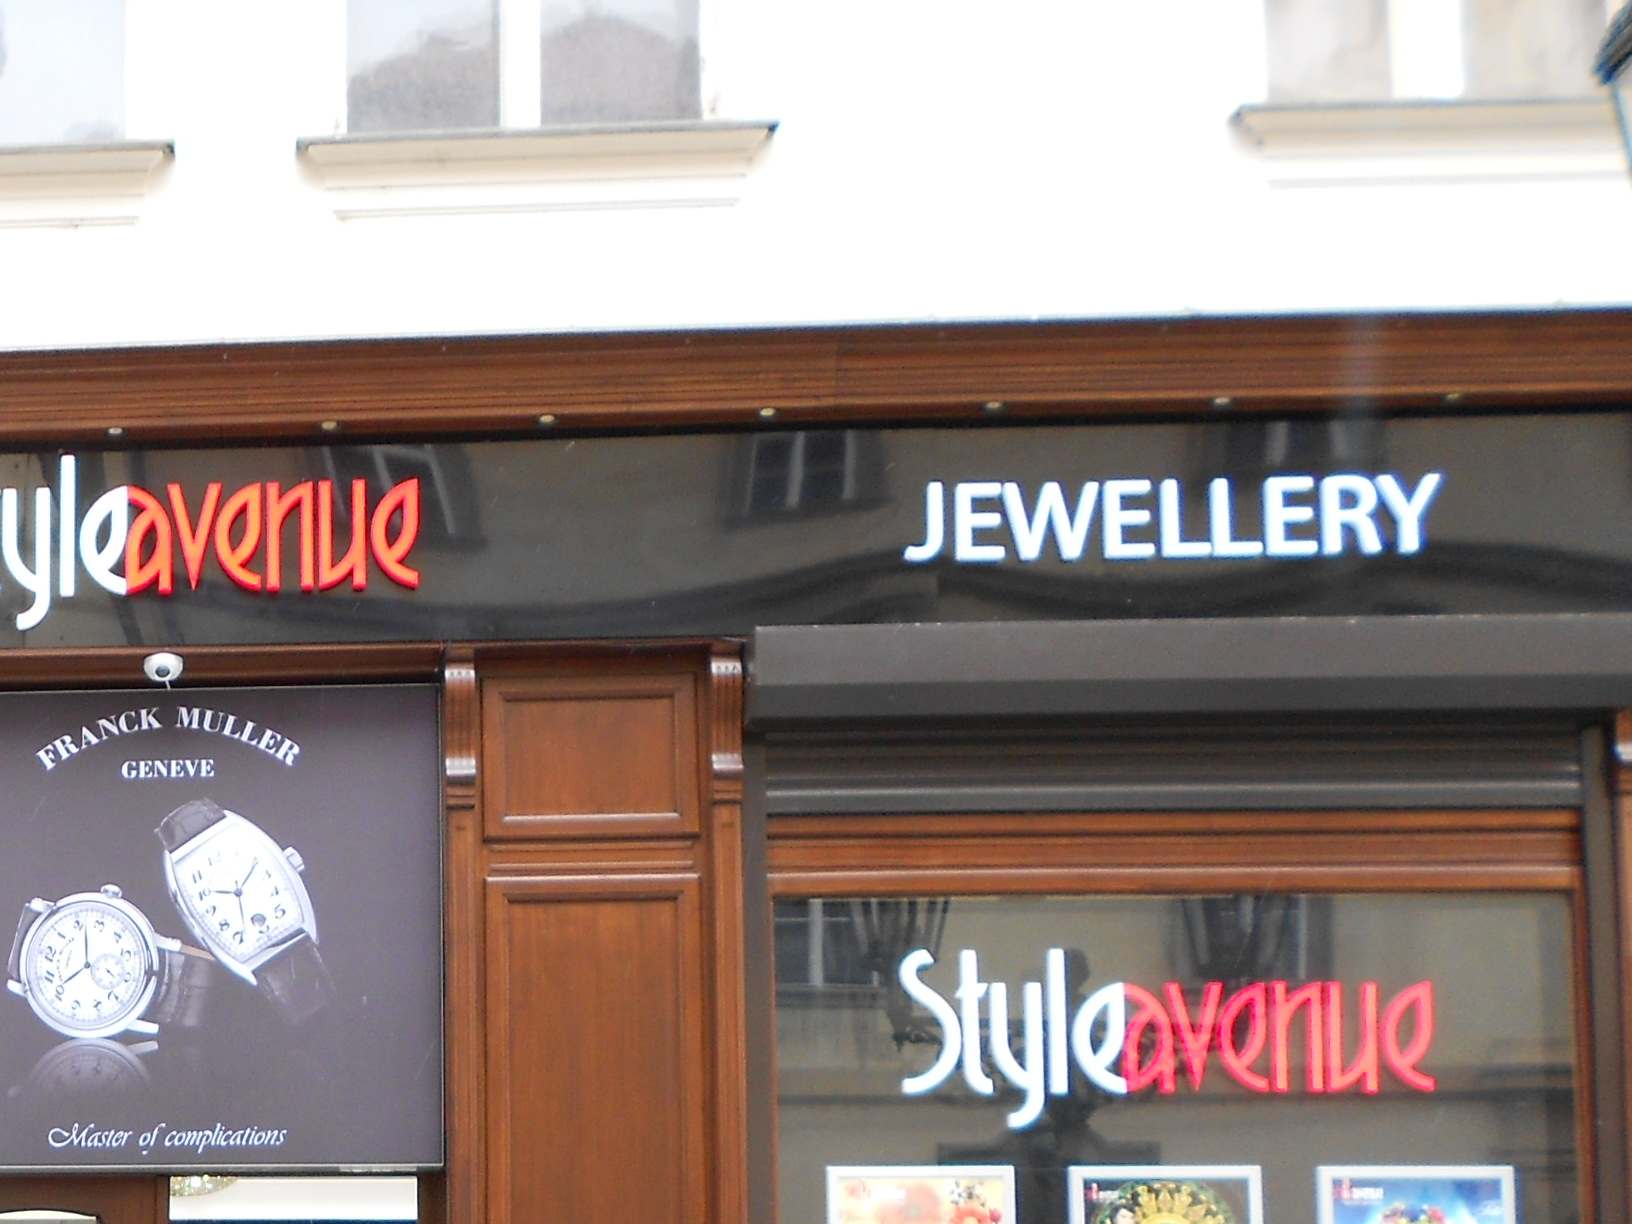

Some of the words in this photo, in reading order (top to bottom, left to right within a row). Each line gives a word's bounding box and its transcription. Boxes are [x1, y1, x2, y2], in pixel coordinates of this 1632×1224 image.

[903, 471, 1442, 563] JEWELLERY
[36, 706, 164, 772] FRANCK
[174, 706, 301, 767] MULLER
[120, 758, 216, 779] GENEVE
[47, 1122, 133, 1148] Master
[138, 1122, 166, 1155] of
[164, 1122, 288, 1153] complications
